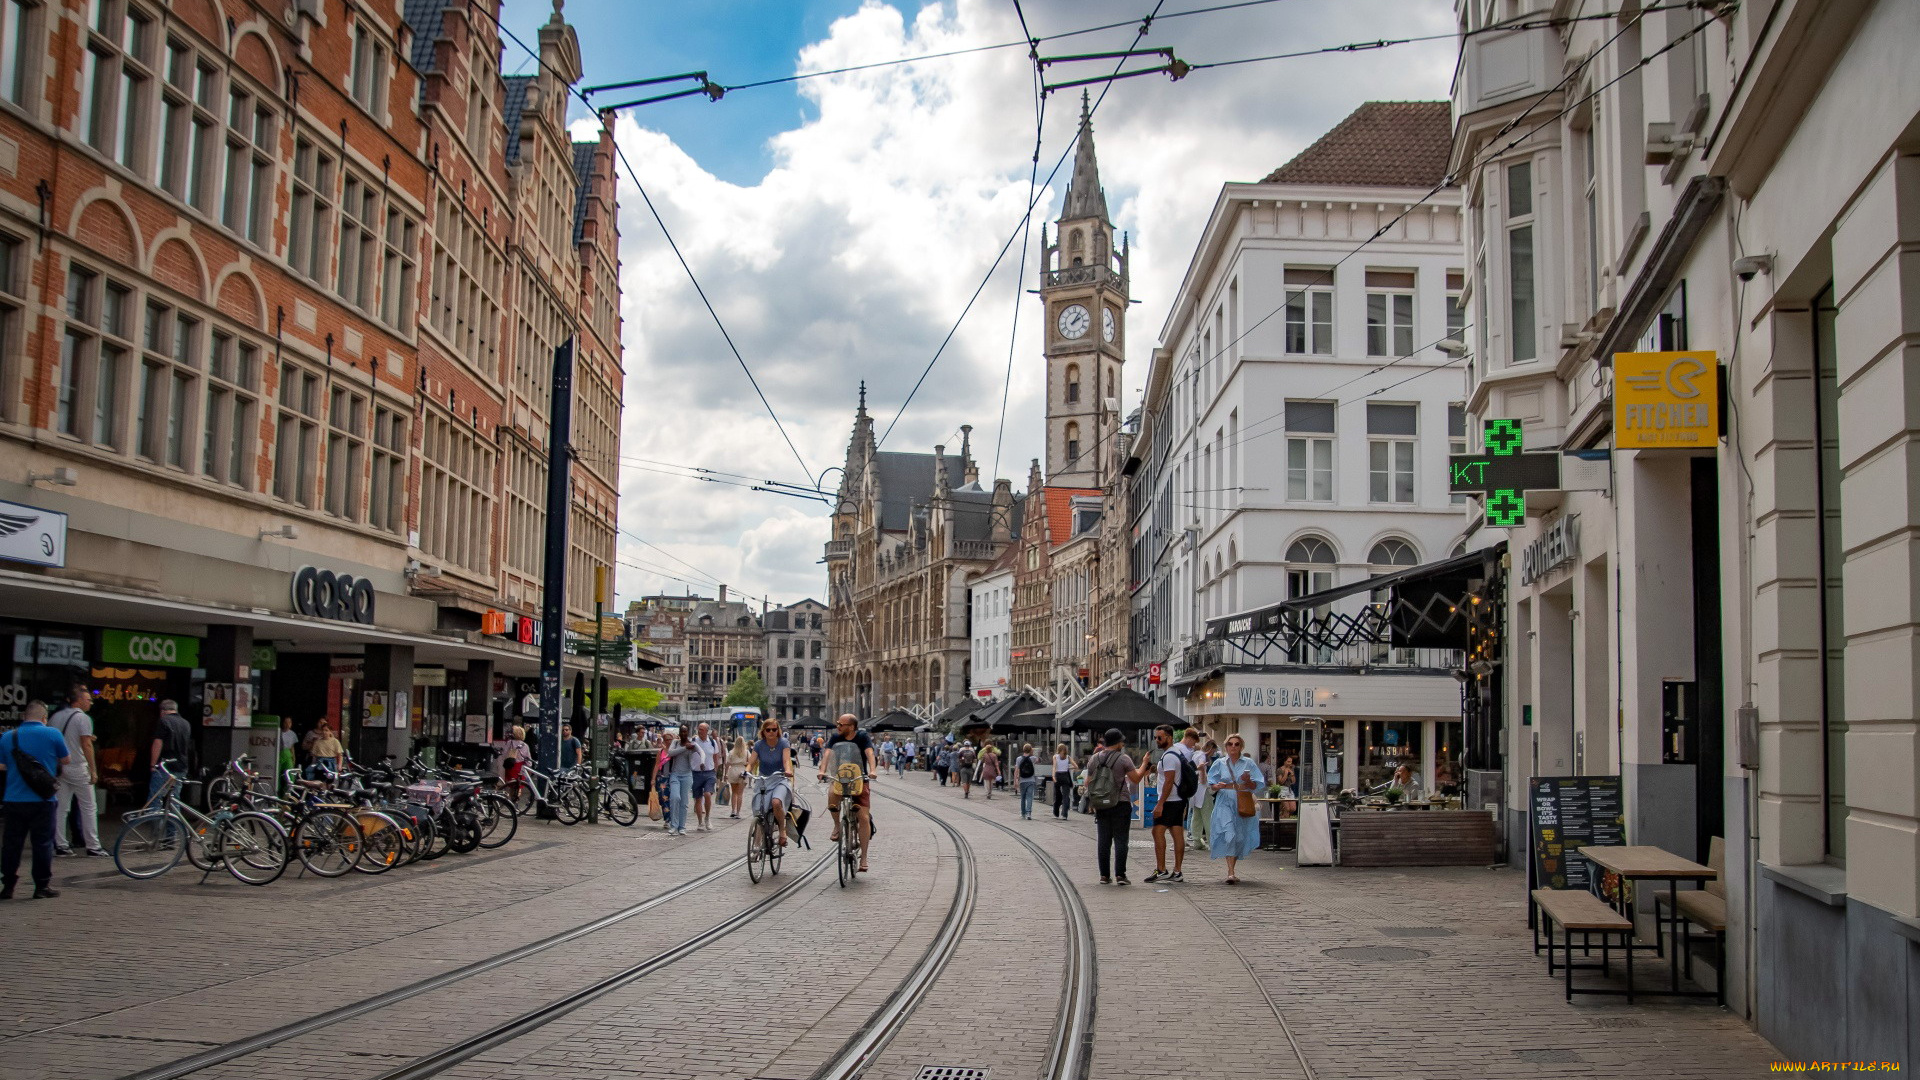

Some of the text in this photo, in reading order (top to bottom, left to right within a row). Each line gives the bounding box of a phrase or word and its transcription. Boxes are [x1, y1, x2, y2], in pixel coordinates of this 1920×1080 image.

[1626, 402, 1708, 429] FITCHEN
[1449, 462, 1491, 485] KT
[129, 636, 176, 662] casa
[1239, 687, 1314, 707] WASBAR
